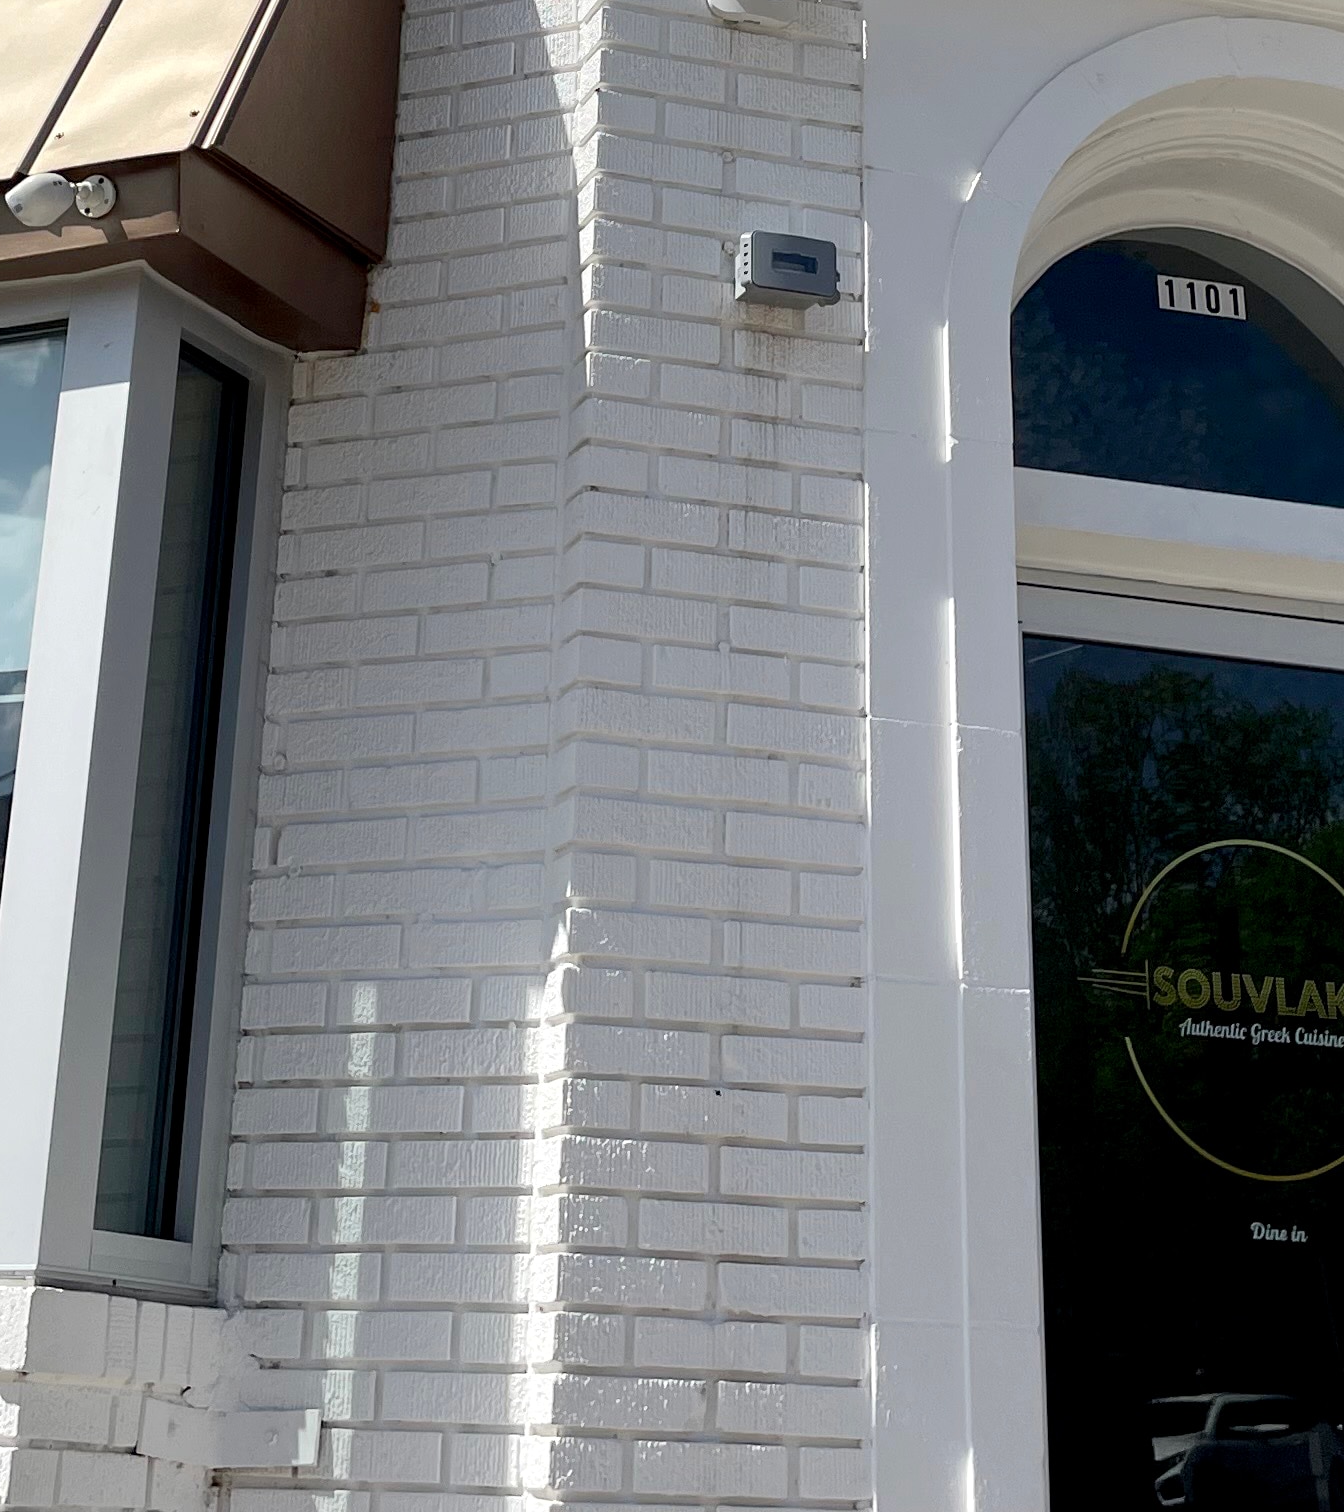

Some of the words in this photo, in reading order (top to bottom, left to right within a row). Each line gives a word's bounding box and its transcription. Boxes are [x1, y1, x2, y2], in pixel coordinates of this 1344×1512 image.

[1164, 279, 1240, 316] 1101
[1178, 1017, 1248, 1040] Authentic
[1250, 1023, 1291, 1046] Greek
[1250, 1221, 1288, 1242] Dine
[1290, 1226, 1308, 1243] in
